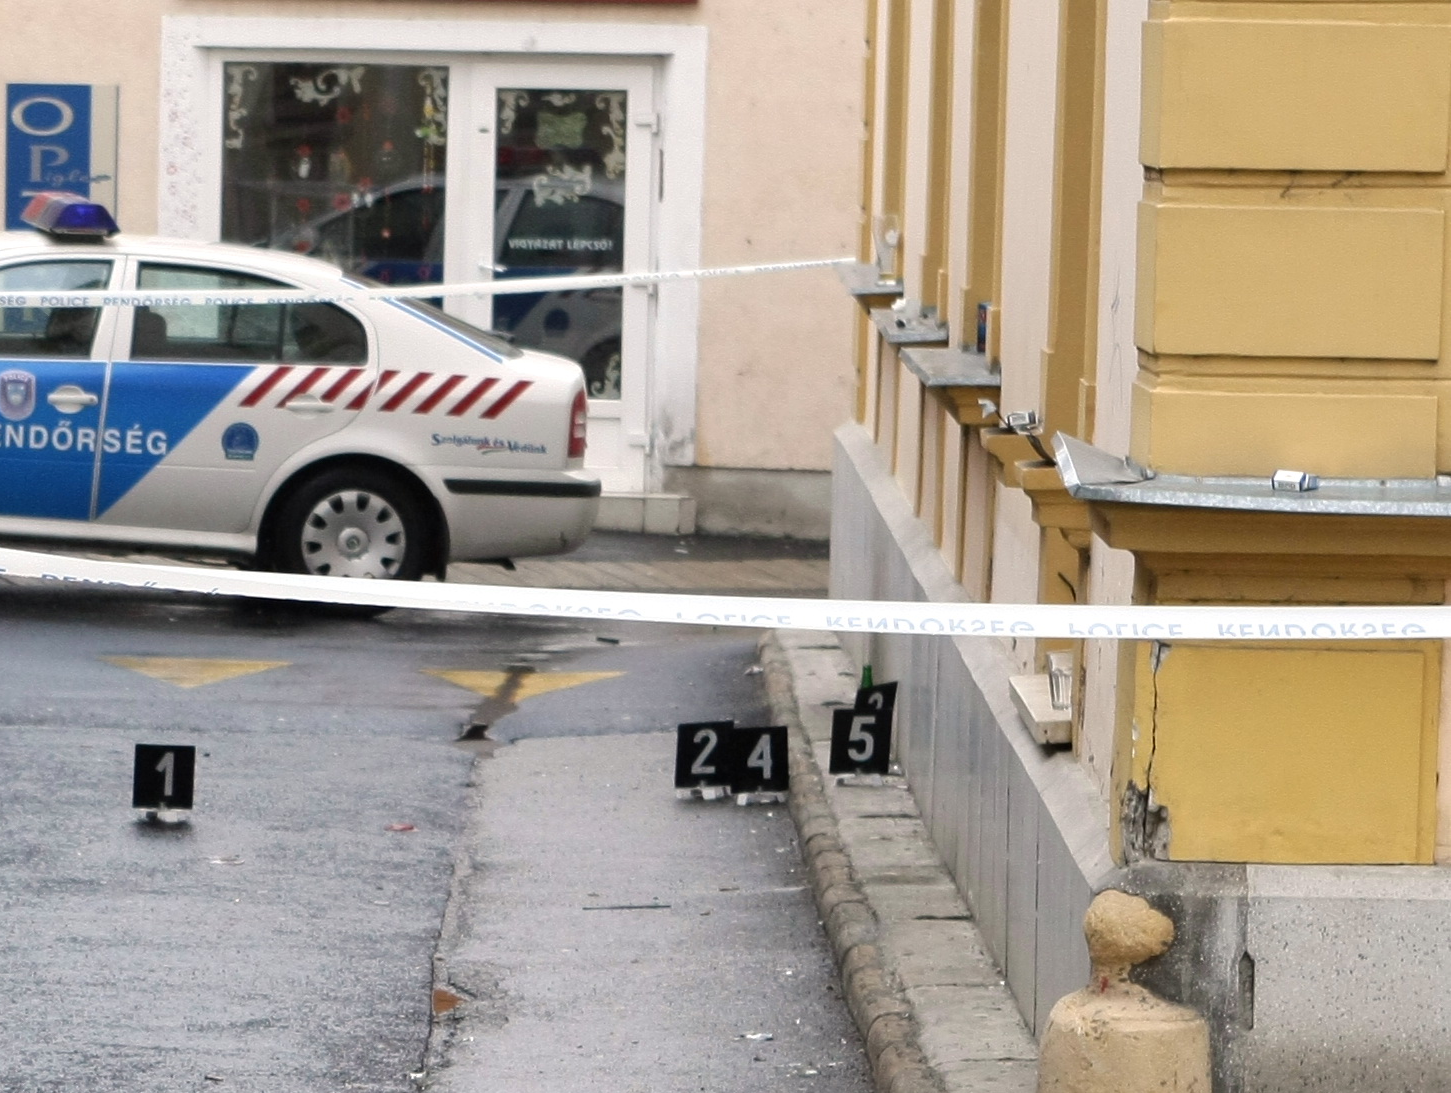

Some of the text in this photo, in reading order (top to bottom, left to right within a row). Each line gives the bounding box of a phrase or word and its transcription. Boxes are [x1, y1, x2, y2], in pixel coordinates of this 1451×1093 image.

[40, 296, 90, 306] POLICE
[690, 729, 718, 775] 2
[747, 734, 773, 779] 4
[847, 716, 877, 762] 5
[155, 751, 175, 797] 1
